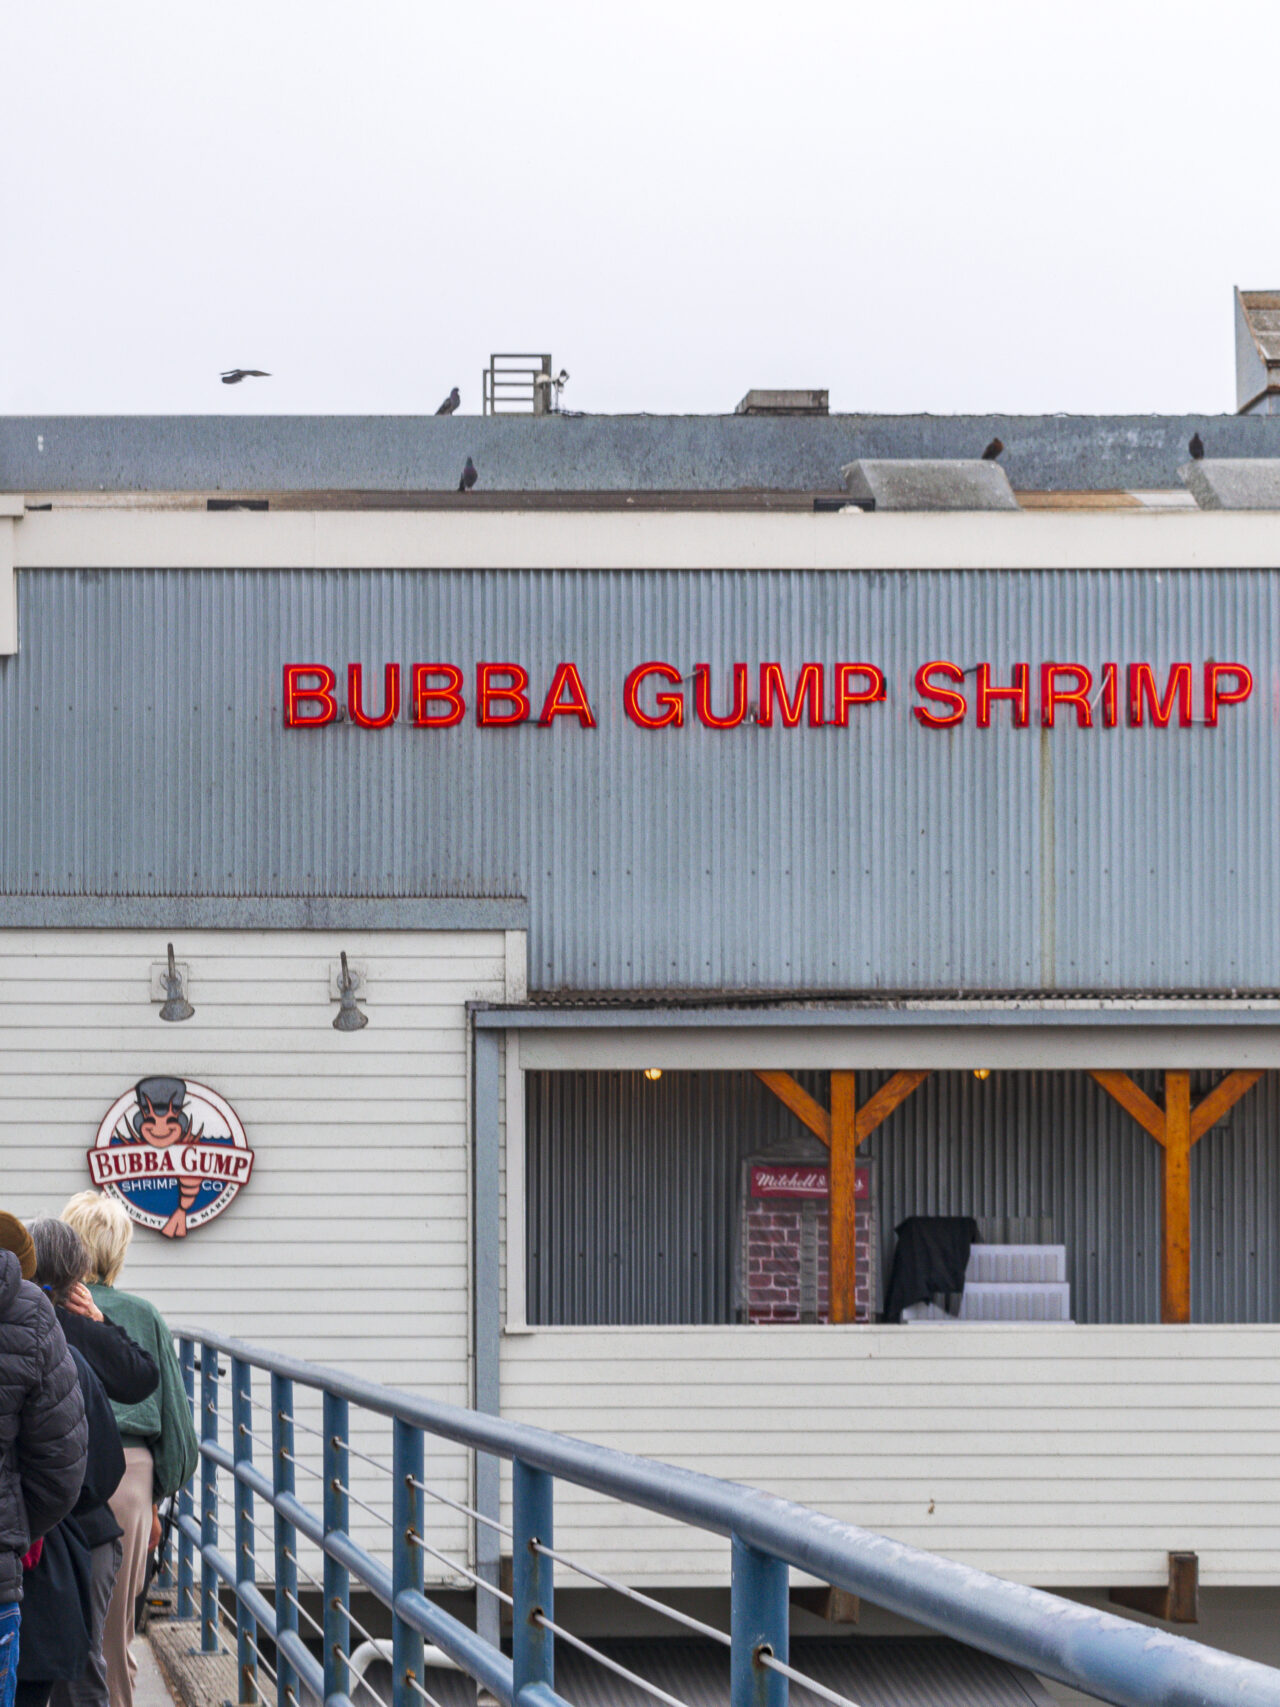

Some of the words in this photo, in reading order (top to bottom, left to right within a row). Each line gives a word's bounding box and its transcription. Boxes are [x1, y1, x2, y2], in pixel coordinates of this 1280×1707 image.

[283, 663, 596, 730] BUBBA
[623, 661, 888, 730] GUMP
[913, 660, 1254, 730] SHRIMP
[95, 1150, 175, 1179] BUBBA
[181, 1145, 248, 1178] GUMP
[121, 1178, 178, 1193] SHRIMP
[755, 1171, 816, 1187] Mitchell
[200, 1186, 236, 1219] MARKET
